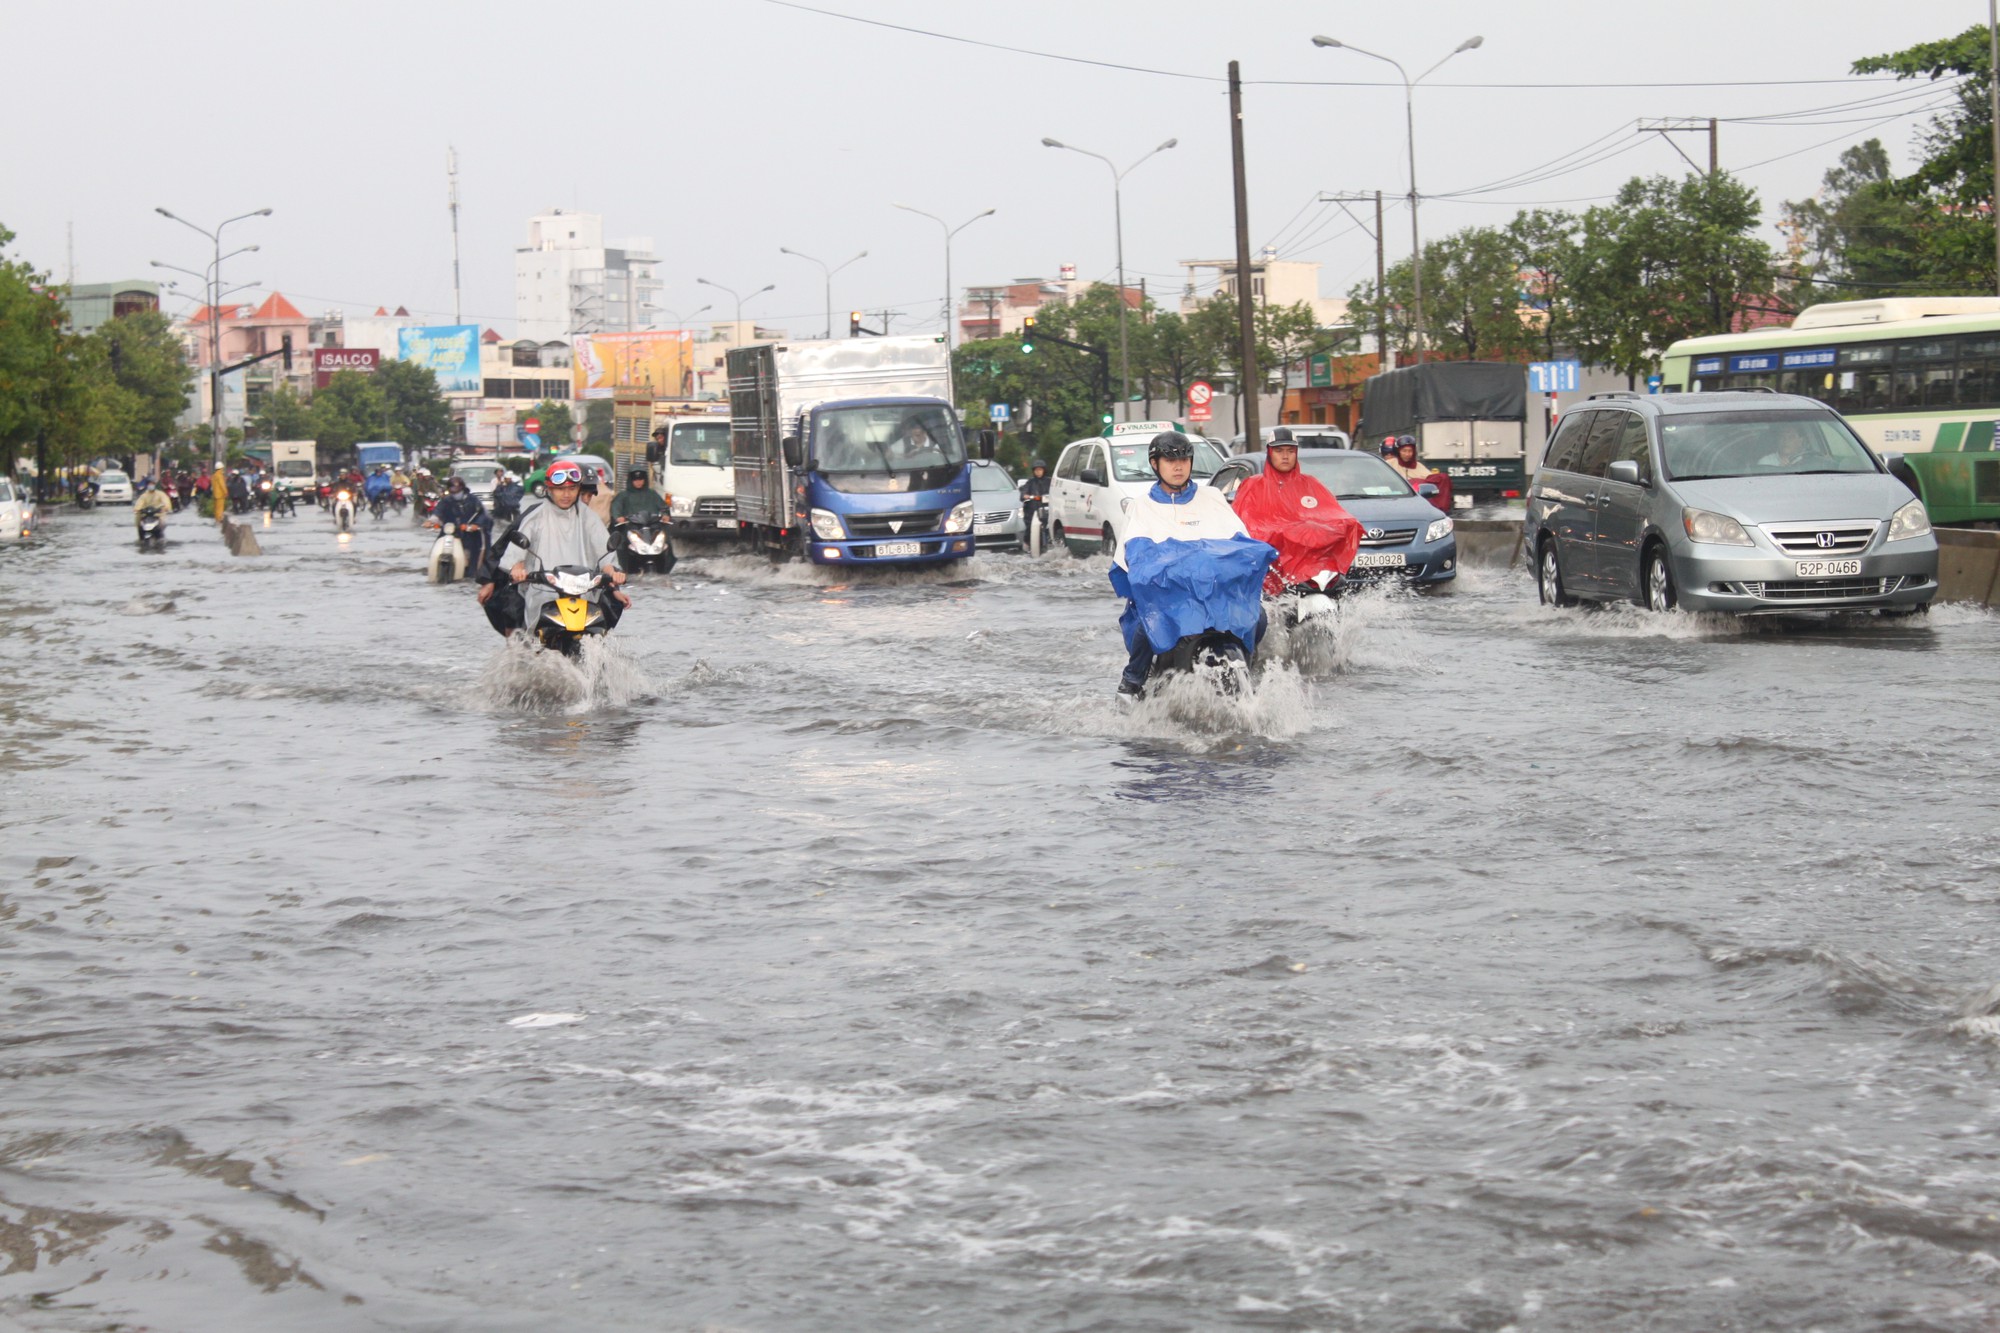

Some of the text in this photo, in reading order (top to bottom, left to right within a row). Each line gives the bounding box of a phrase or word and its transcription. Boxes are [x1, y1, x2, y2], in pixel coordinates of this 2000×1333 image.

[321, 353, 372, 365] ISALCO
[1357, 554, 1403, 566] 52U-0928
[1800, 561, 1858, 576] 52P-0466
